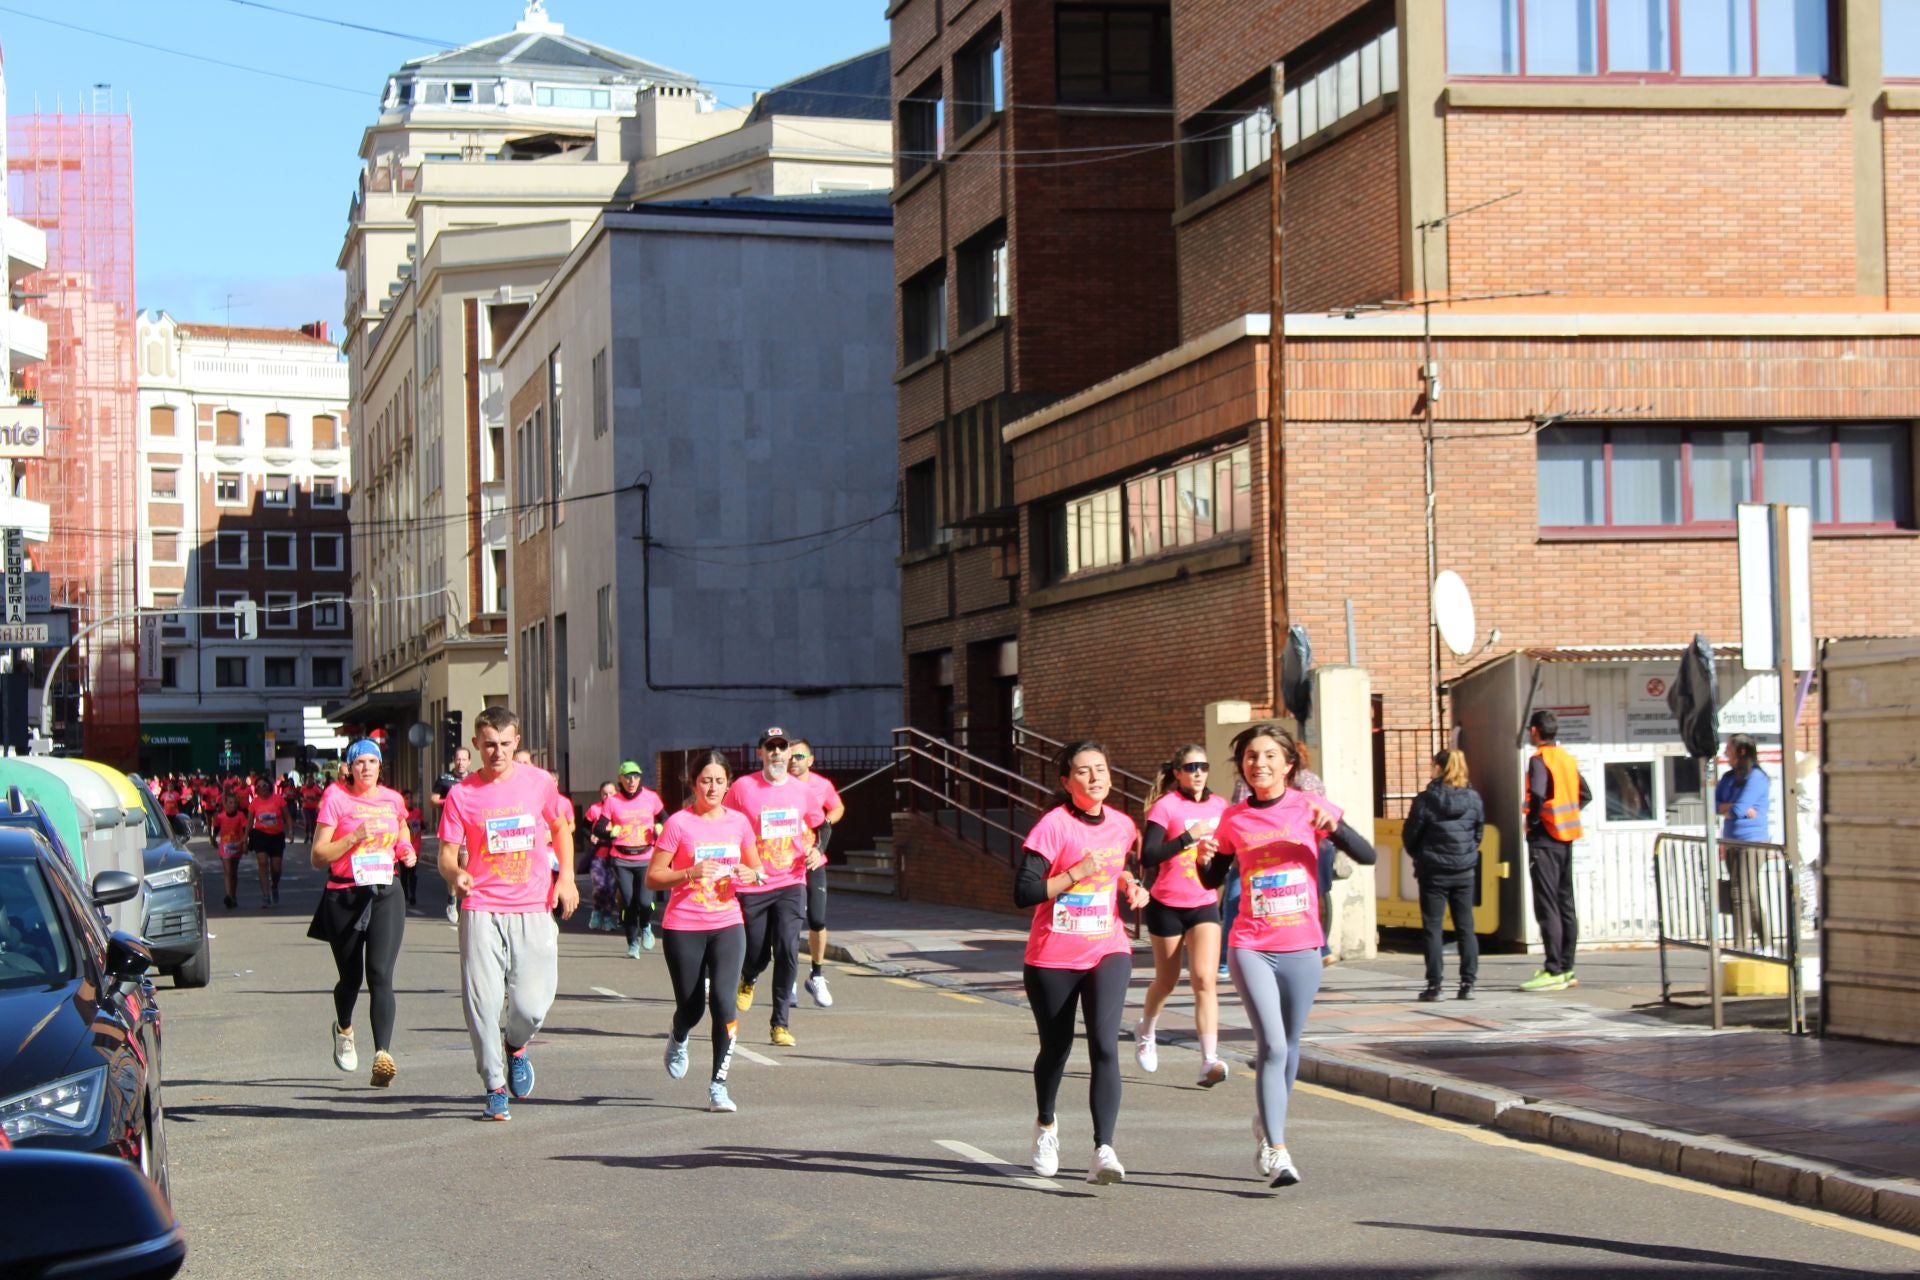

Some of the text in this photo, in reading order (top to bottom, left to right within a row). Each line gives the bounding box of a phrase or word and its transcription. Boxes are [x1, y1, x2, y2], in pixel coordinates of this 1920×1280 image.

[8, 528, 22, 622] PELUQUERIA
[0, 627, 46, 641] ABEL
[168, 736, 190, 744] RURAL
[506, 827, 526, 837] 1347
[1271, 885, 1298, 898] 3207
[1076, 906, 1097, 917] 3151
